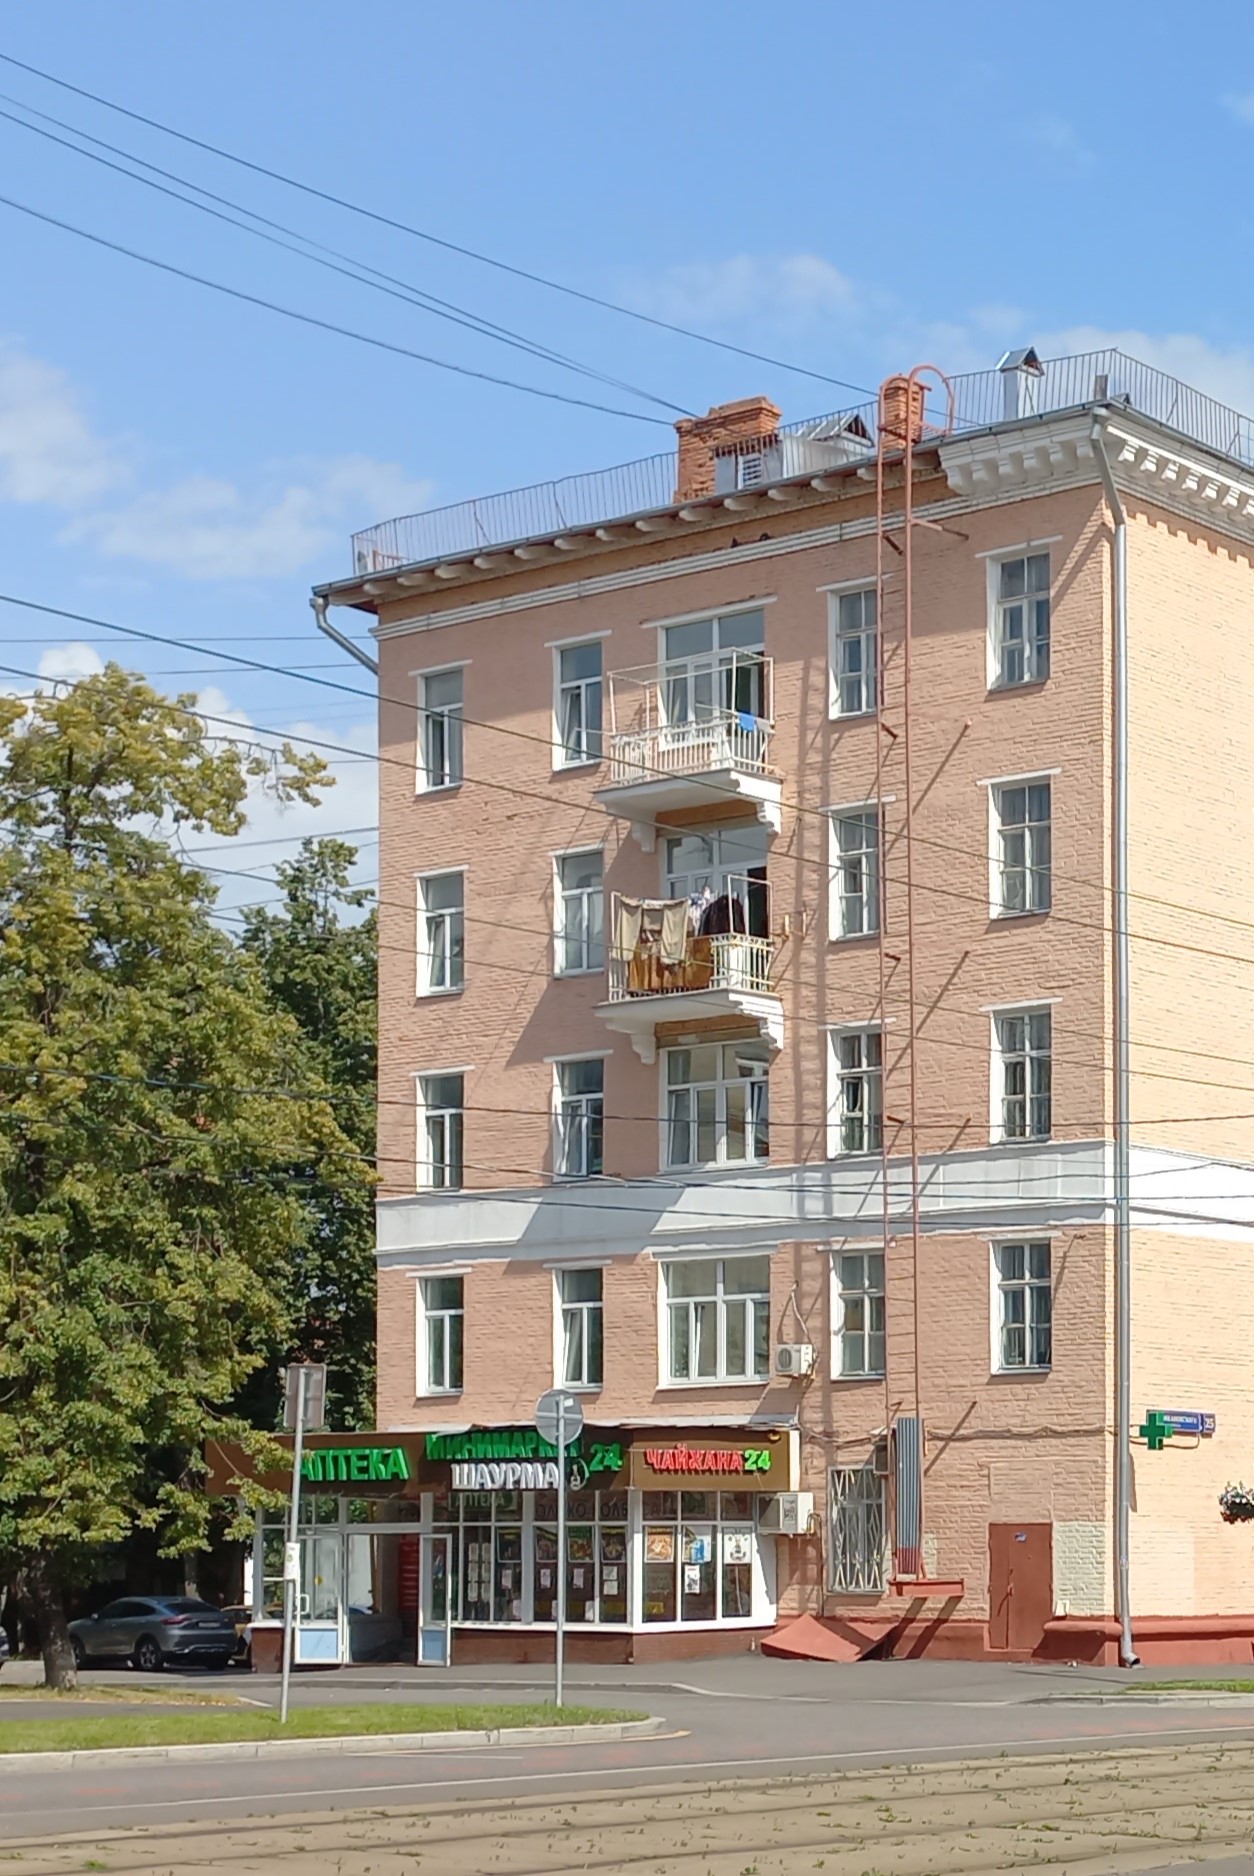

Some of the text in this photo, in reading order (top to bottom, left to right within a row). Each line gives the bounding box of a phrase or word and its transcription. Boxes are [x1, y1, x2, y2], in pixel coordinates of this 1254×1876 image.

[1204, 1417, 1215, 1429] 25
[425, 1431, 623, 1472] МИНИМАРК 24
[451, 1461, 560, 1490] ШАУРМА
